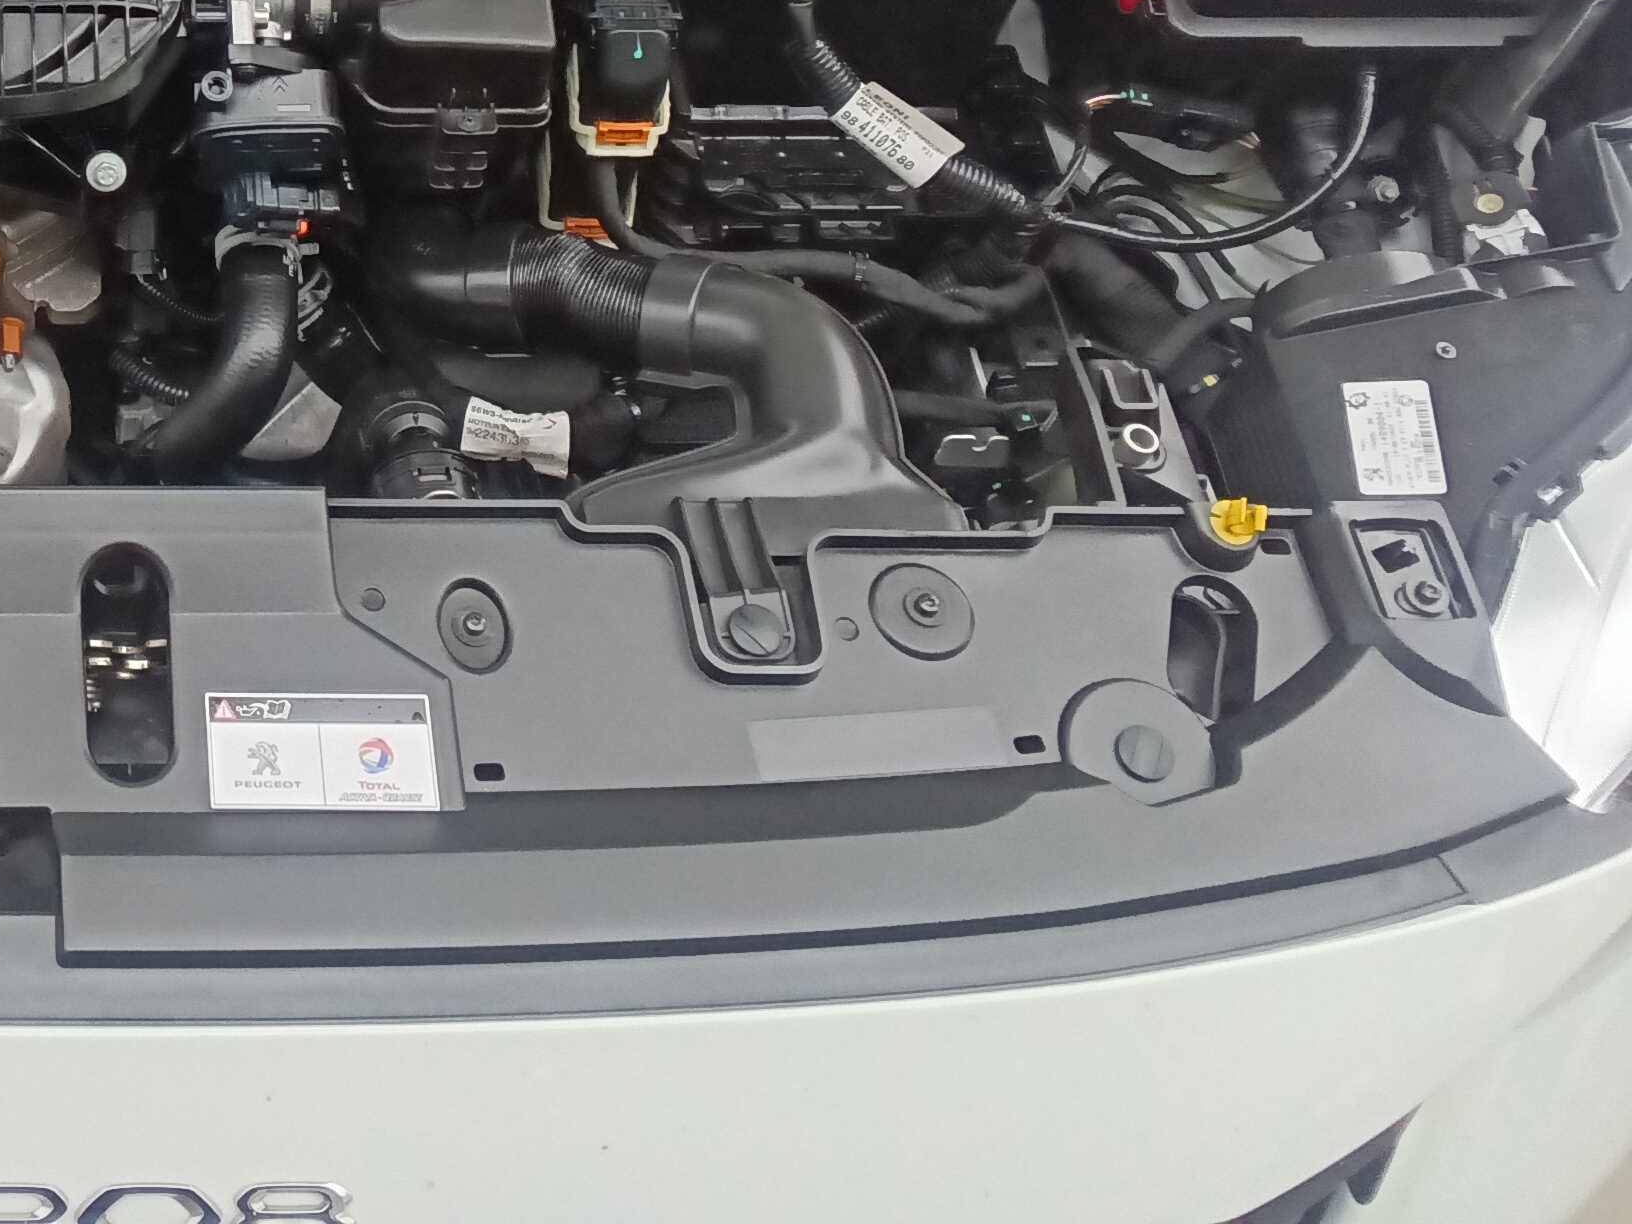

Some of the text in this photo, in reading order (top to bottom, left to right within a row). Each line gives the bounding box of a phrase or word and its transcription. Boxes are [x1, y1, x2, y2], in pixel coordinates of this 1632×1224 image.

[840, 110, 859, 126] 98
[858, 120, 903, 158] 411076
[896, 154, 916, 171] 80
[234, 780, 302, 789] PEUGEOT
[357, 780, 401, 791] TOTAL
